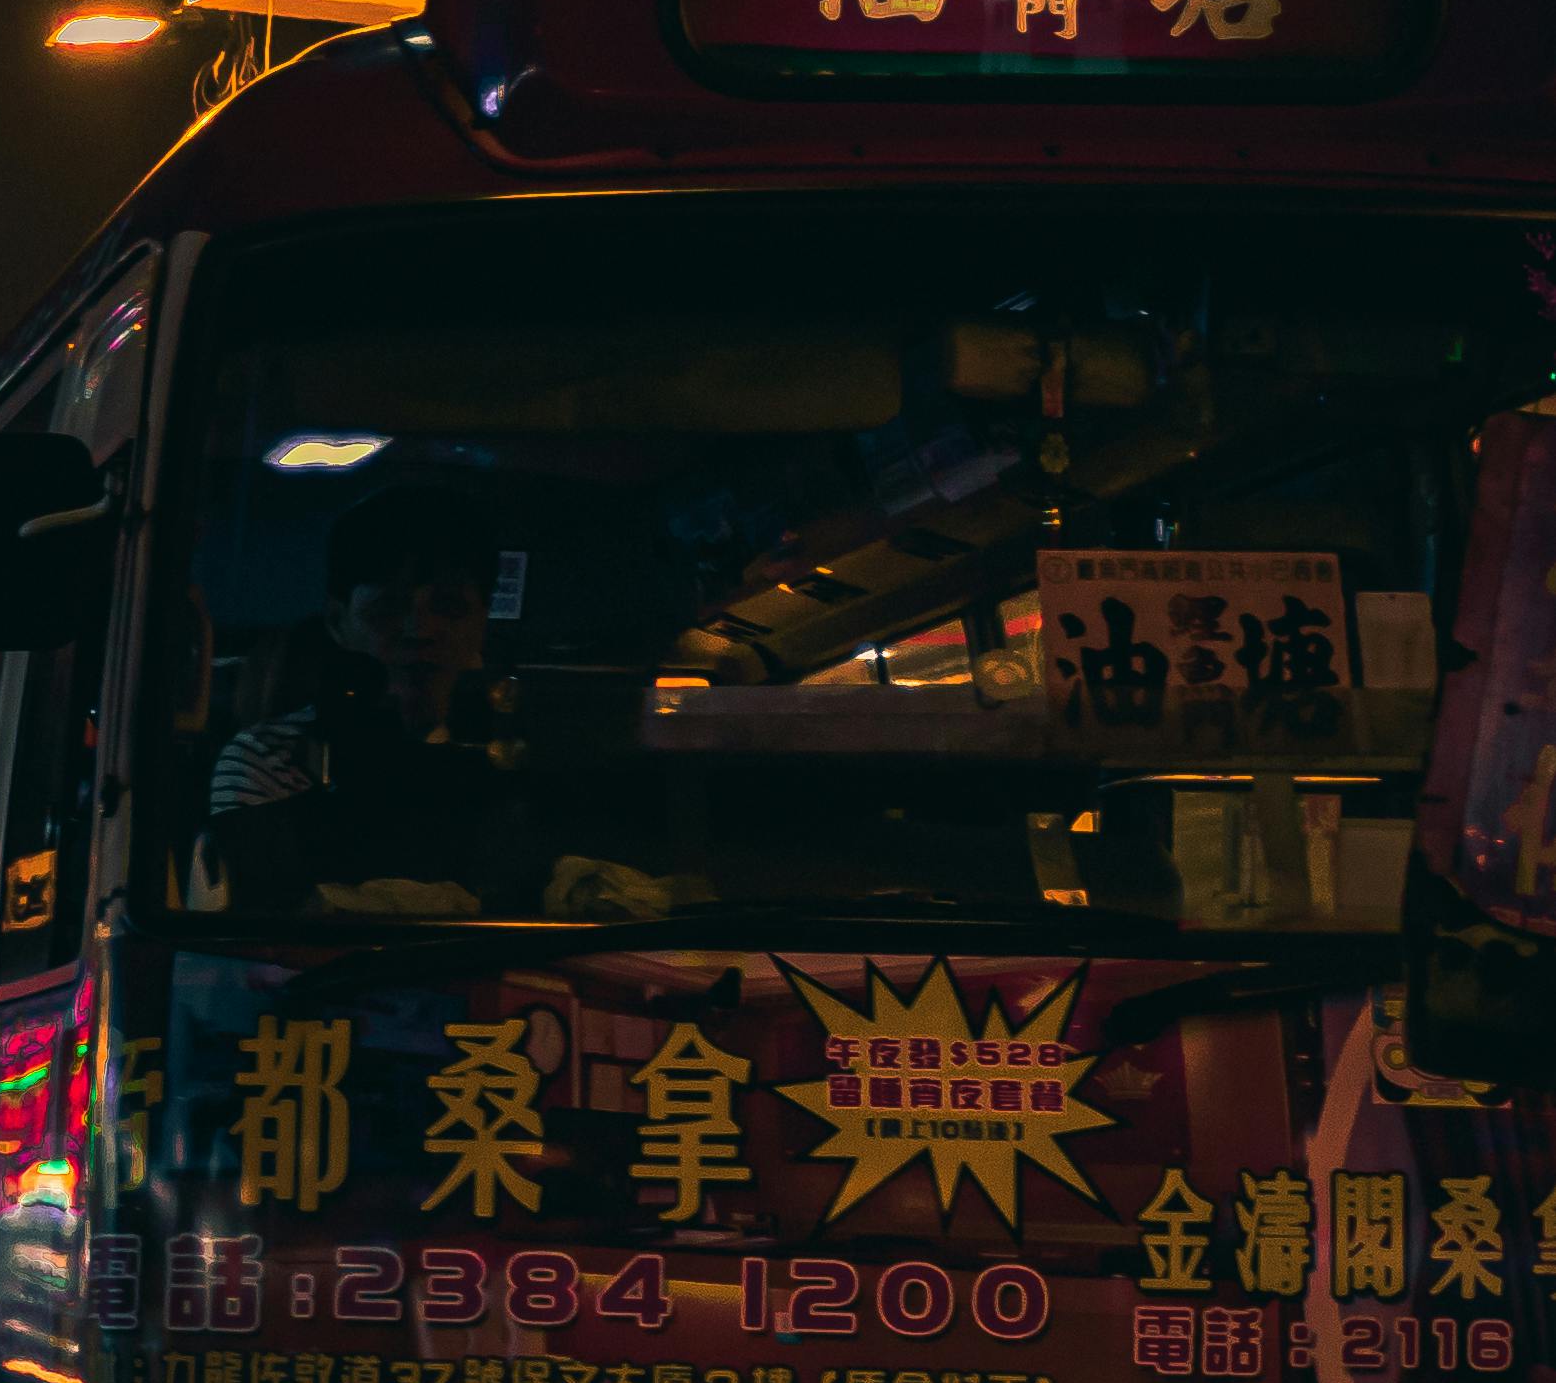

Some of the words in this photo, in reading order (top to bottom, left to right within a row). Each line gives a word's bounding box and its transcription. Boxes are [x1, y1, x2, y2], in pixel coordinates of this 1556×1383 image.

[1136, 1166, 1556, 1301] 金濤閣桑
[739, 1255, 1051, 1341] 1200
